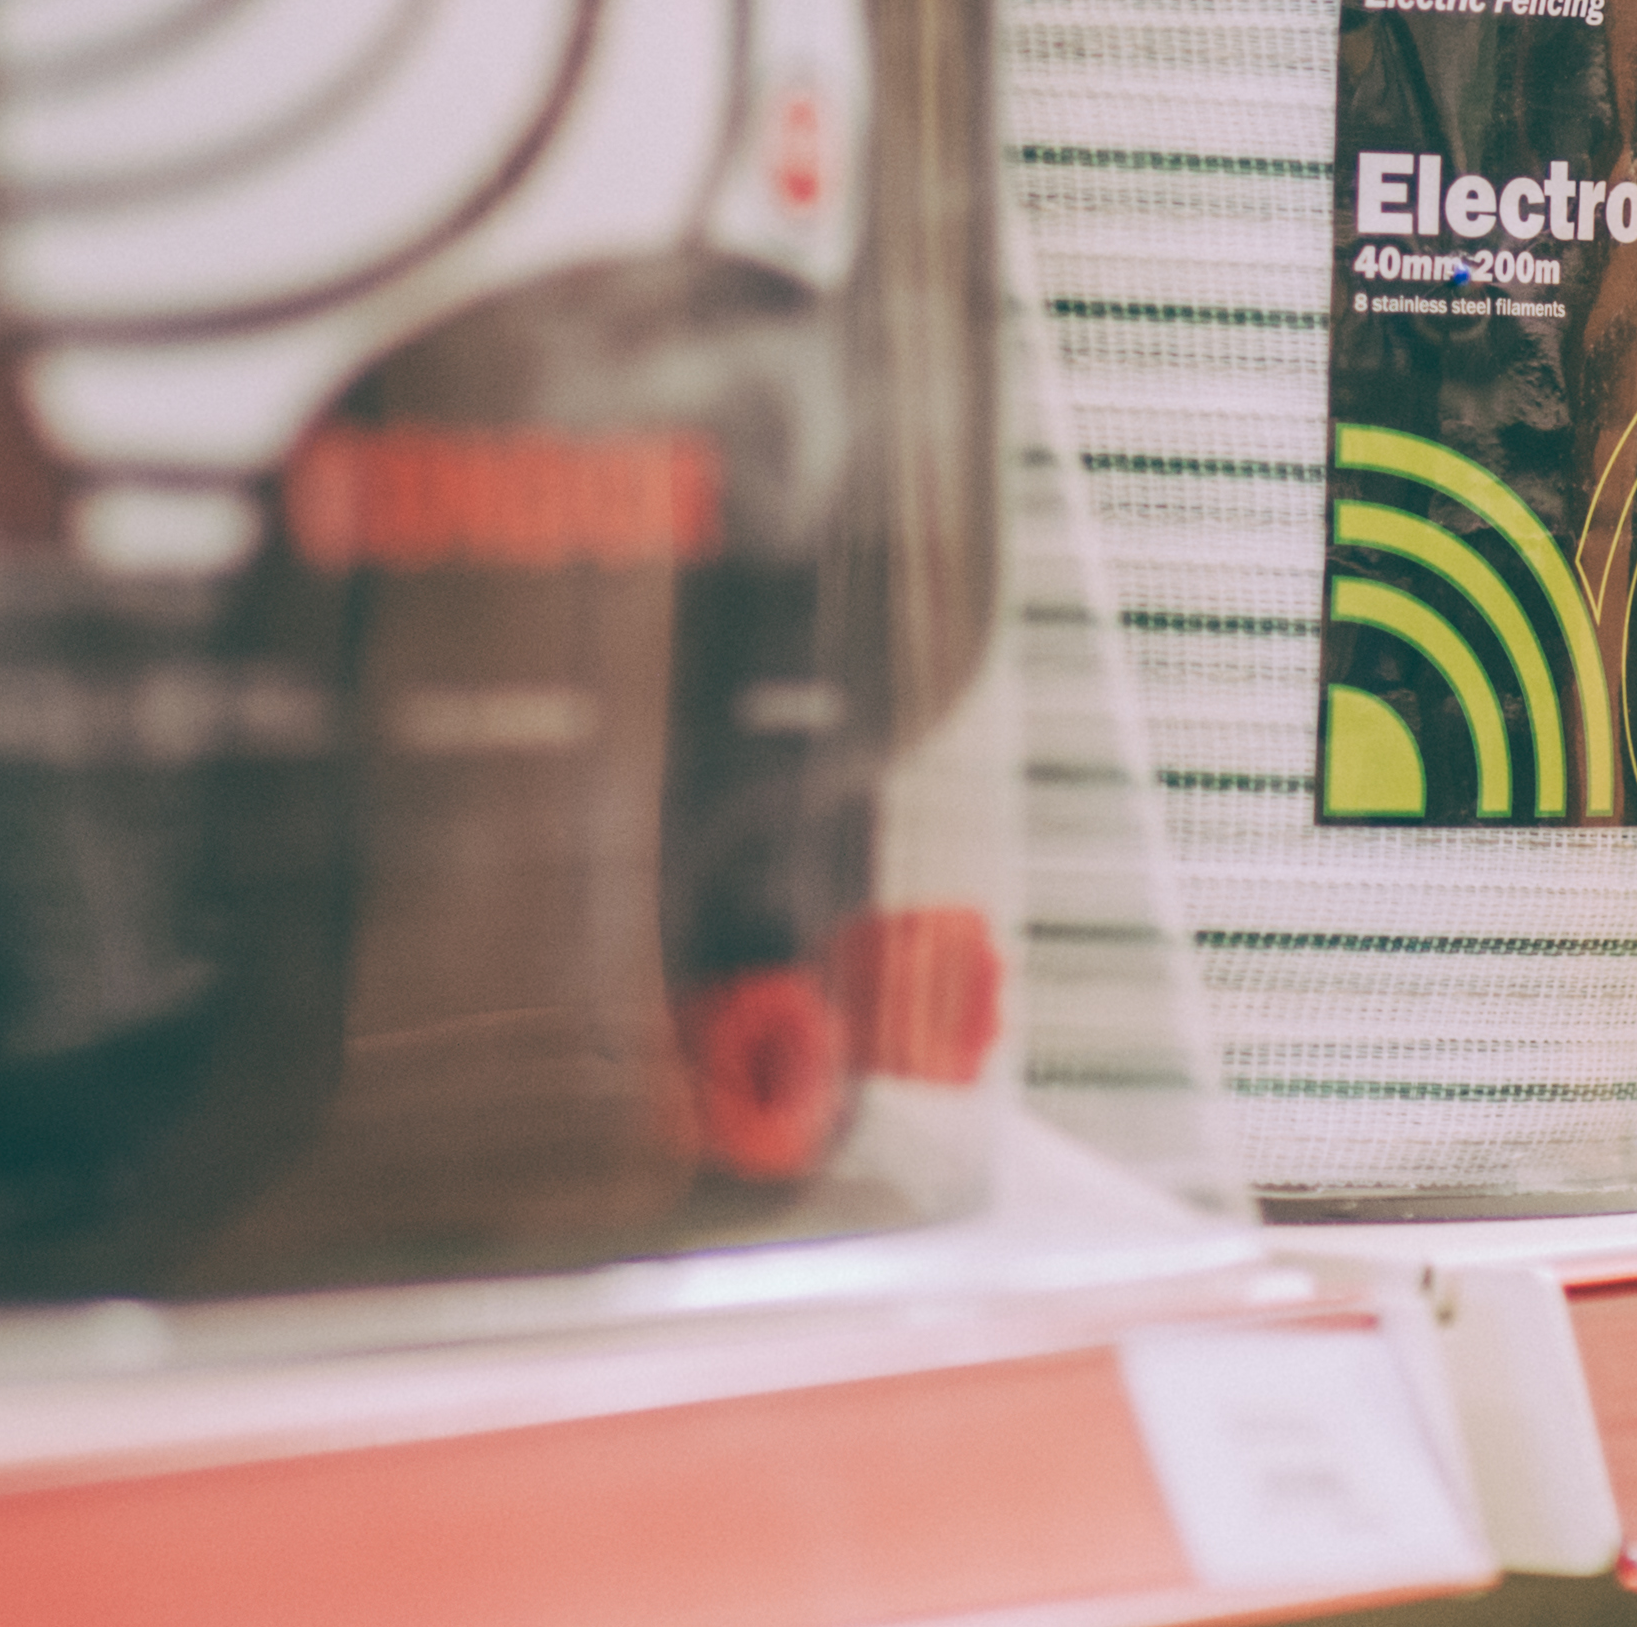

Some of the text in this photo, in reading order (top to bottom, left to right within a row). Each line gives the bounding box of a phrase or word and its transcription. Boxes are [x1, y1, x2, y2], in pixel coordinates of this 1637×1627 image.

[1354, 293, 1567, 319] 8 stainless steel filaments
